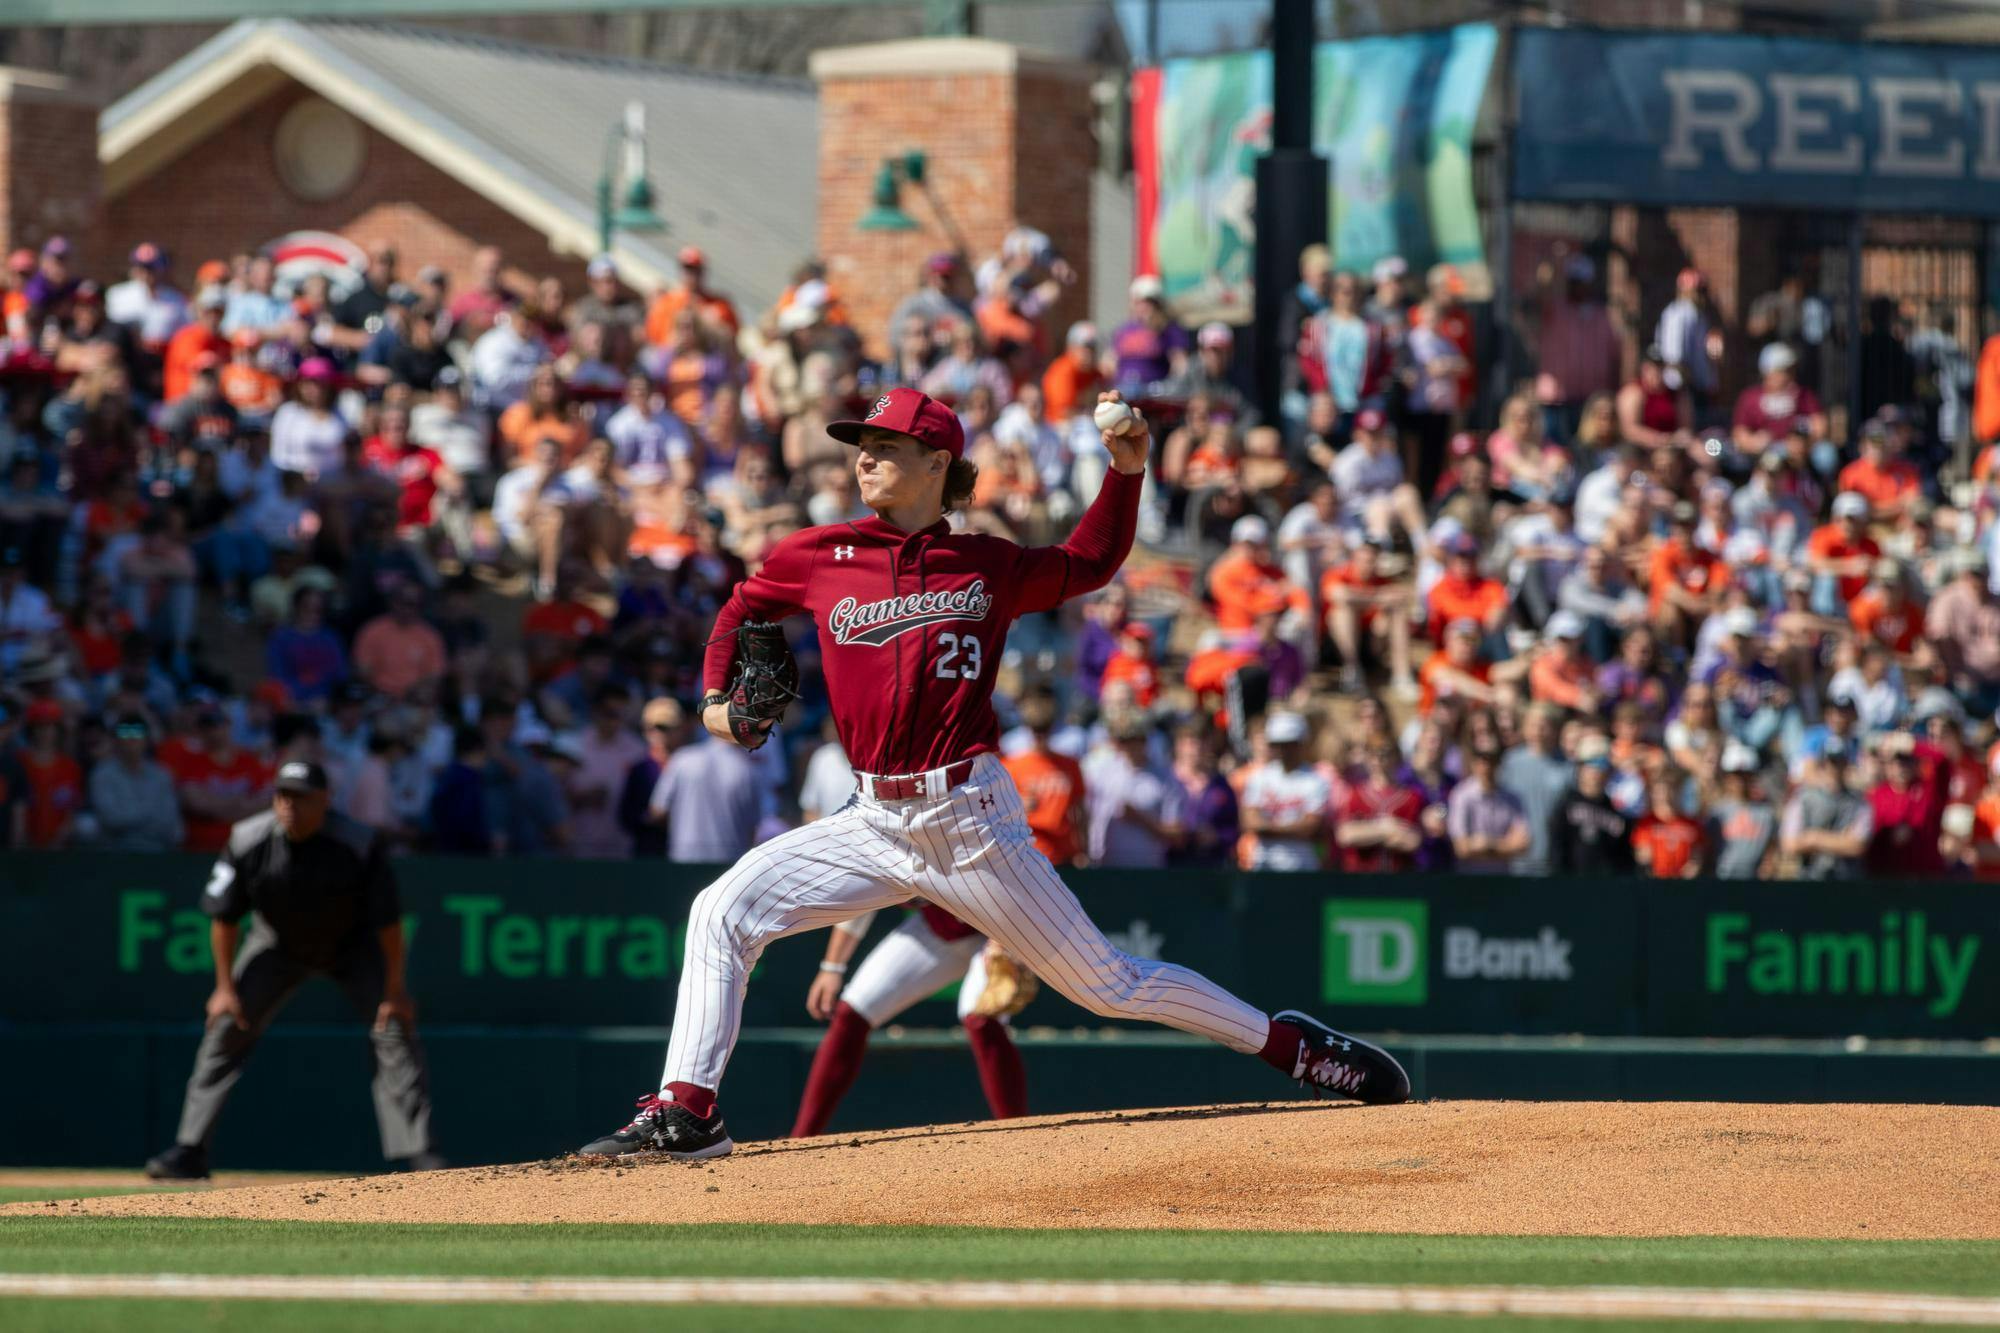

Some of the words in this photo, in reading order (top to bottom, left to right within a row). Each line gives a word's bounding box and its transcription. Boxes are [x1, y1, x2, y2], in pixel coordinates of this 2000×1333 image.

[1660, 69, 2000, 179] REE
[829, 580, 992, 645] Gamecocks
[936, 632, 982, 680] 23
[443, 894, 694, 979] Terra
[1332, 916, 1417, 985] TD
[1444, 926, 1573, 980] Bank
[1706, 911, 1981, 1018] Family
